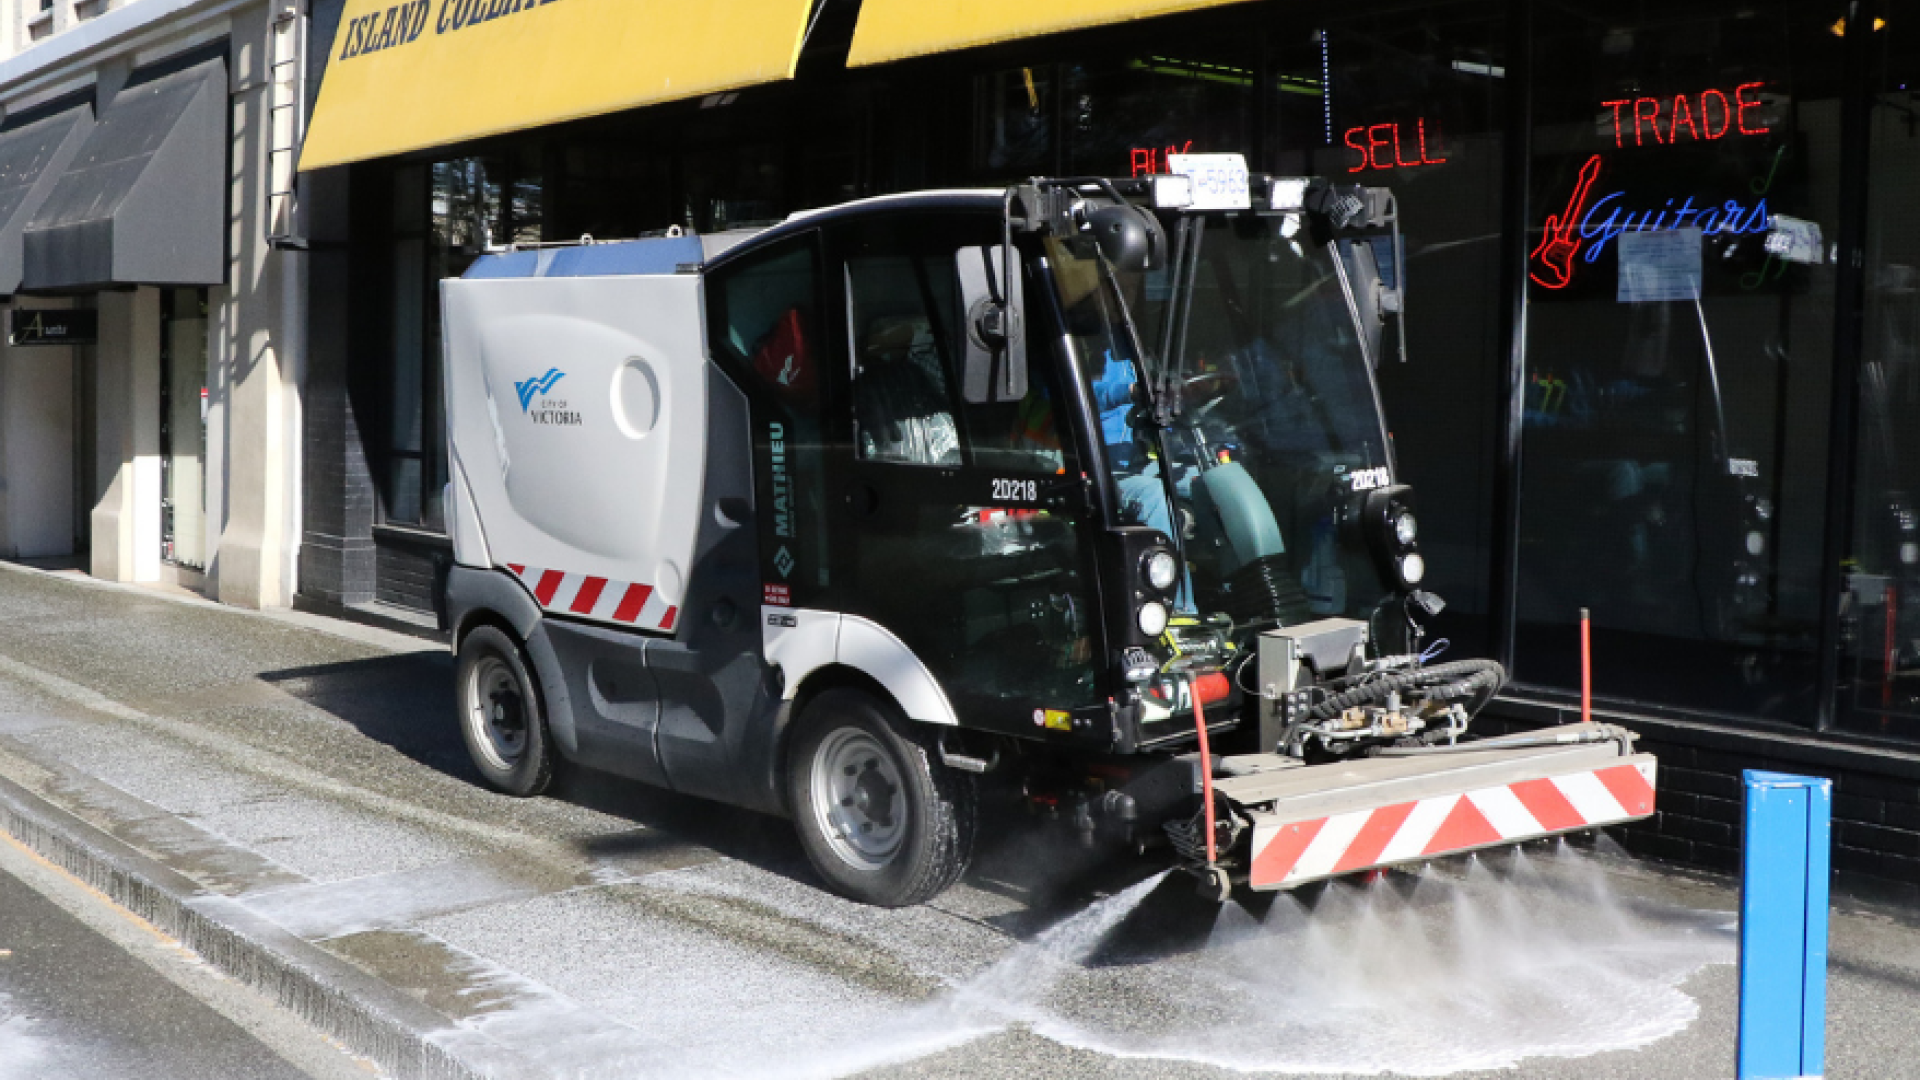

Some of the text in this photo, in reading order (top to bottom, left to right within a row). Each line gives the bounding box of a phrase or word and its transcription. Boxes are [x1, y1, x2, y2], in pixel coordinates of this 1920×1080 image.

[338, 0, 430, 60] ISLAND
[1344, 117, 1446, 172] SELL
[1601, 81, 1770, 148] TRADE
[1580, 191, 1768, 262] Guitars
[530, 410, 582, 426] VICTORIA
[769, 422, 788, 536] MATHIEU
